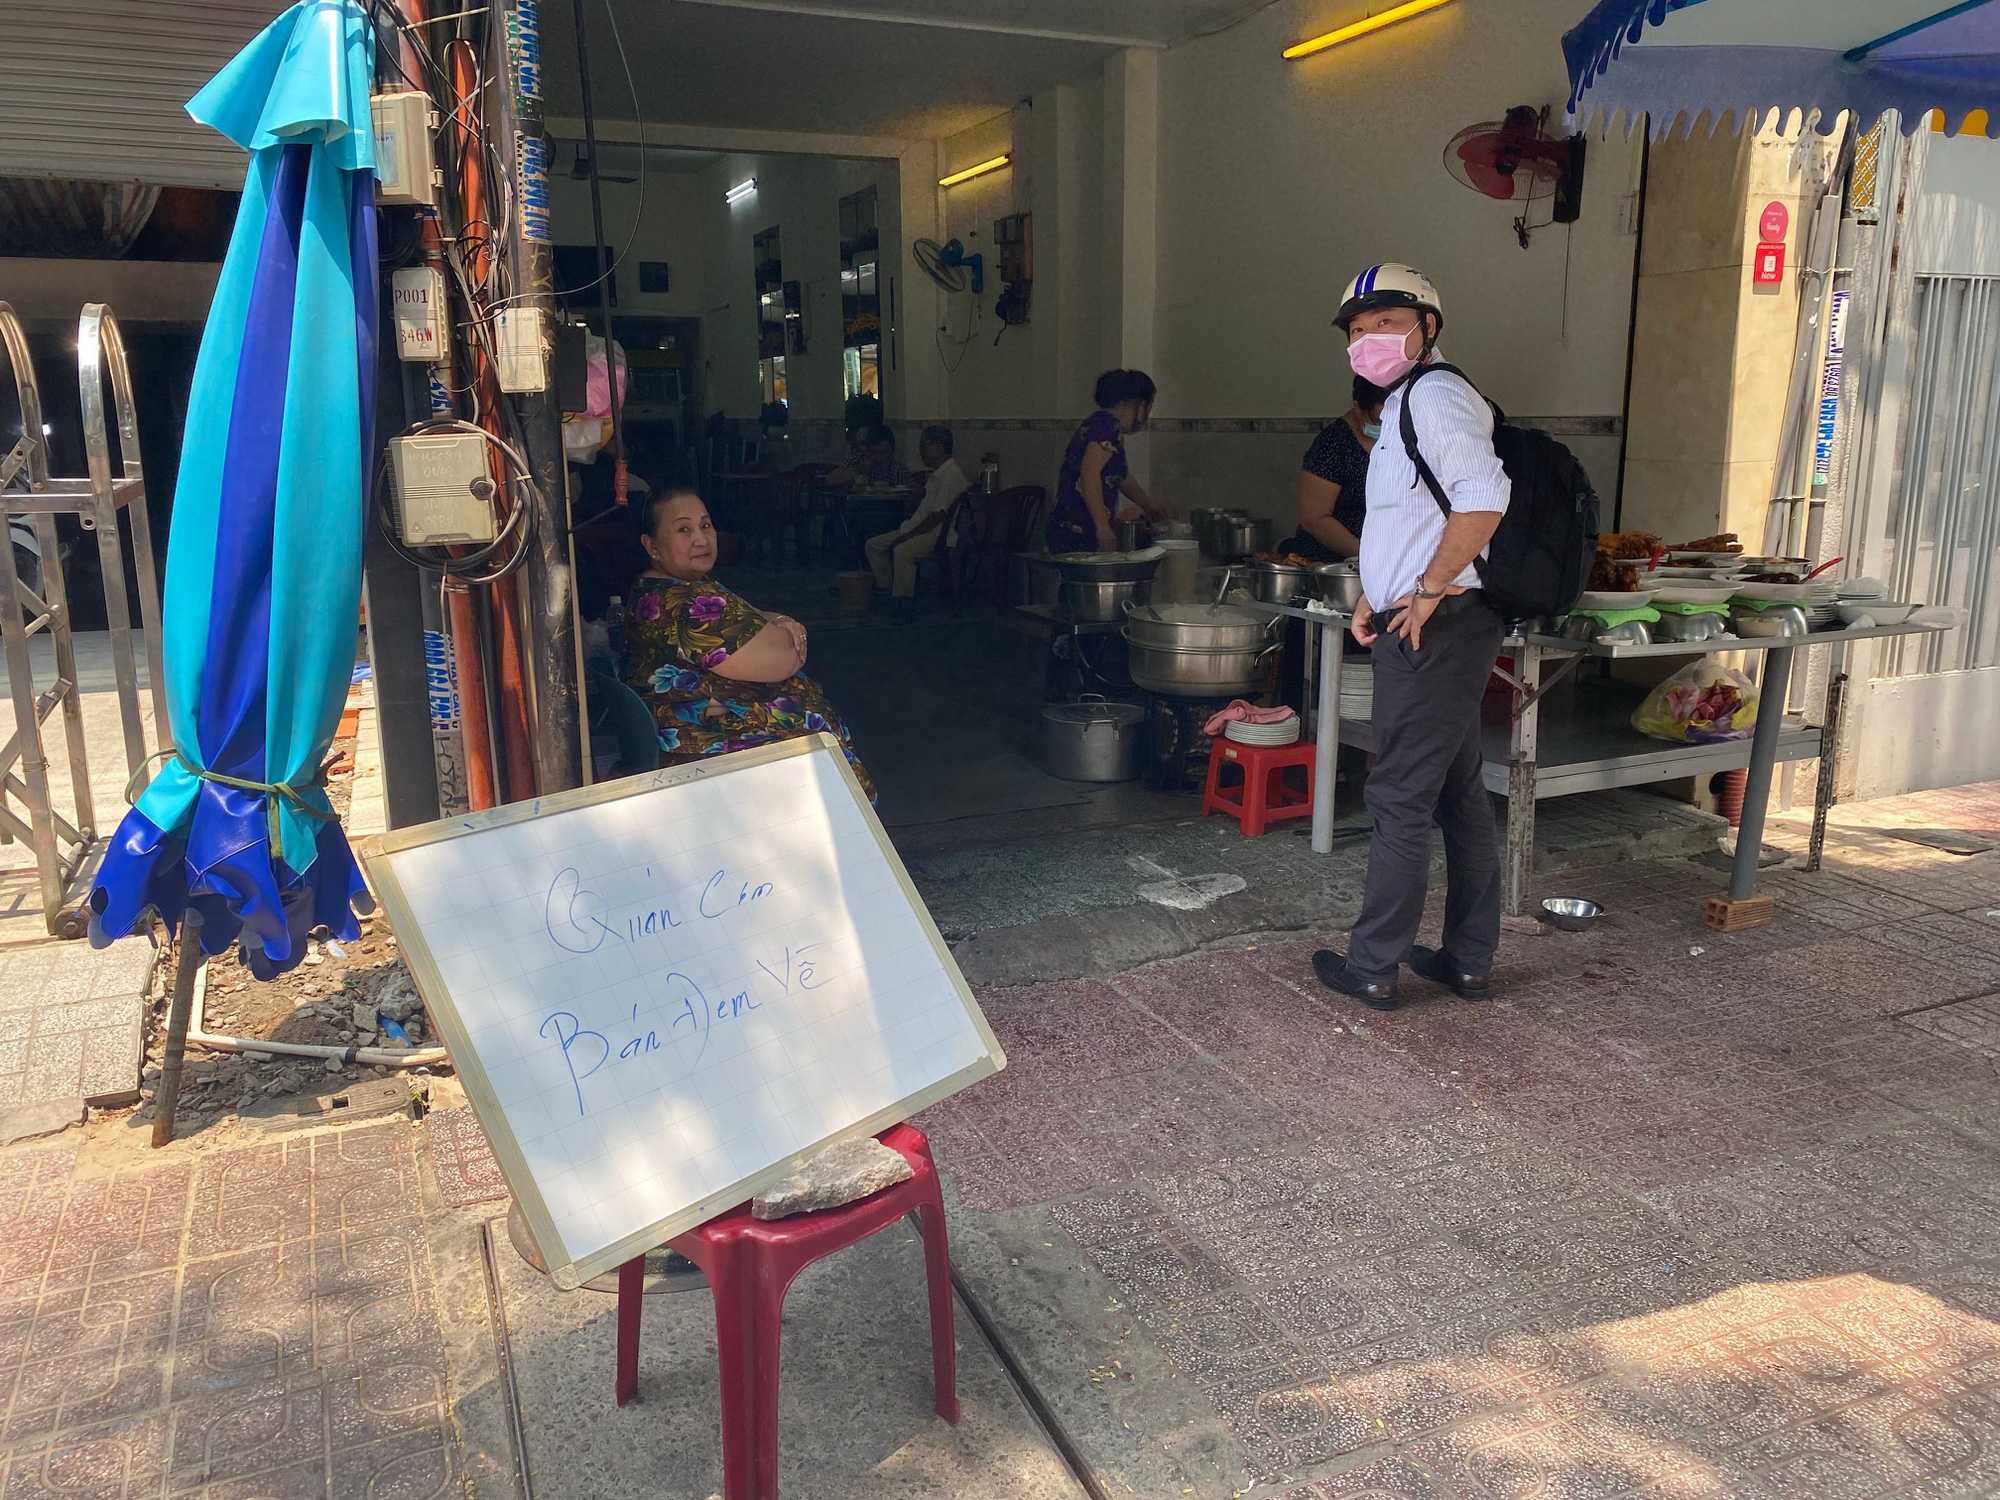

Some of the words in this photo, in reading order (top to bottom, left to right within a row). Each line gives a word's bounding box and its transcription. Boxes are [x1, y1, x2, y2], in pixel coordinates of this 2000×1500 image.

[394, 288, 428, 304] P001
[1761, 272, 1776, 280] Now
[546, 867, 681, 953] Quán
[700, 869, 774, 919] Cơm
[540, 1003, 661, 1116] Bán
[666, 972, 763, 1070] Đem
